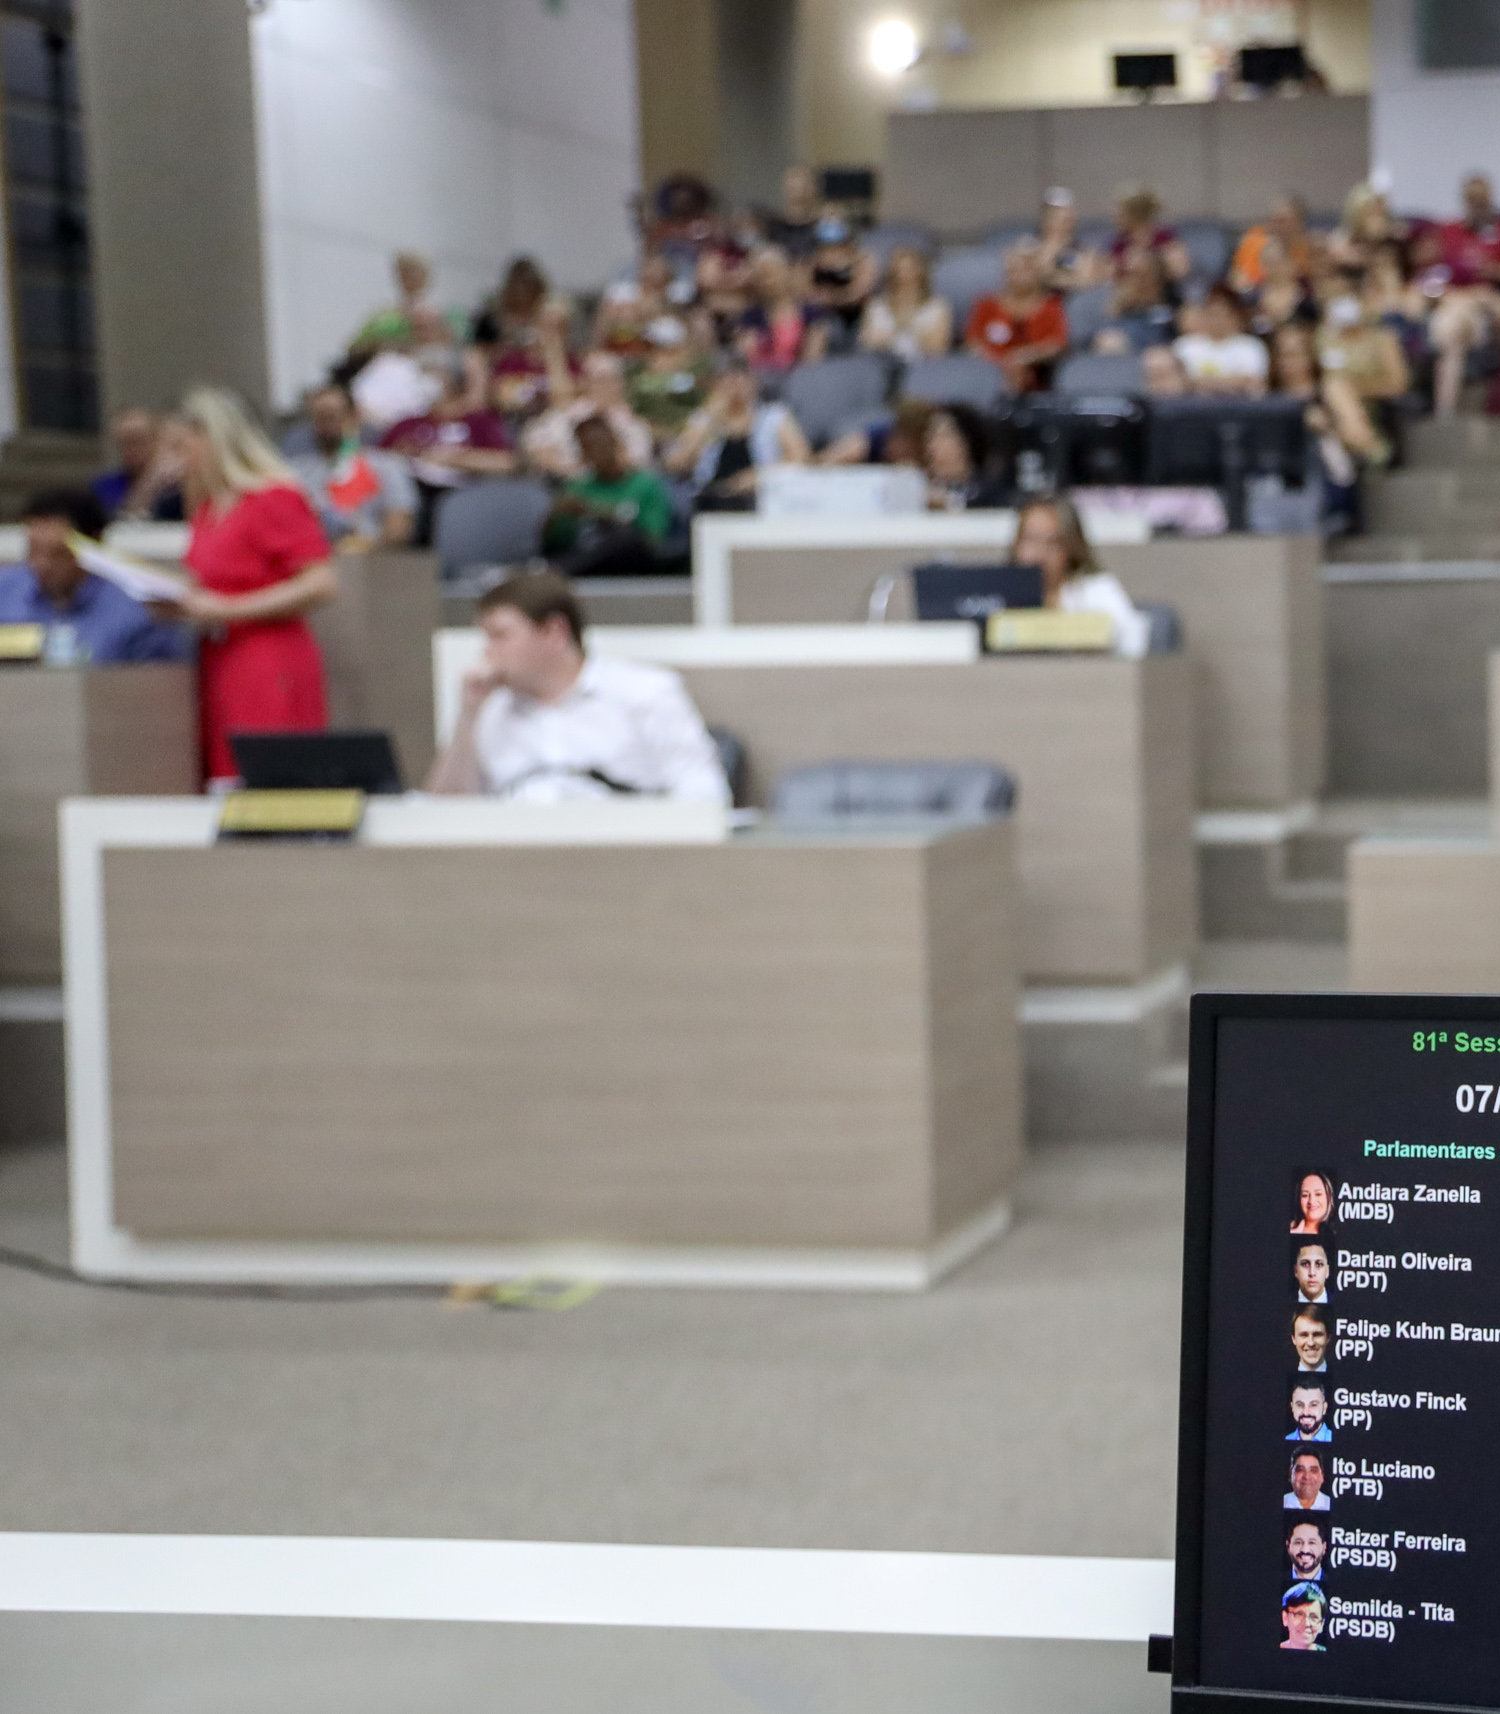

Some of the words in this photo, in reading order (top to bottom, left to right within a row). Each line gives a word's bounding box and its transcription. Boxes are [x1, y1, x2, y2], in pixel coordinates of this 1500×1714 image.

[1364, 1140, 1495, 1159] Parlamentares
[1338, 1183, 1409, 1201] Andiara
[1413, 1185, 1480, 1203] Zanella
[1338, 1202, 1394, 1224] (MDB)
[1338, 1250, 1396, 1268] Darlan
[1401, 1252, 1471, 1271] Oliveira
[1337, 1271, 1387, 1292] (PDT)
[1336, 1319, 1391, 1342] Felipe
[1396, 1321, 1445, 1340] Kuhn
[1335, 1339, 1374, 1361] (PP)
[1334, 1388, 1410, 1408] Gustavo
[1416, 1392, 1466, 1411] Finck
[1334, 1409, 1372, 1430] (PP)
[1333, 1457, 1356, 1475] Ito
[1361, 1459, 1435, 1479] Luciano
[1332, 1477, 1383, 1500] (PTB)
[1331, 1527, 1389, 1547] Raizer
[1394, 1531, 1466, 1552] Ferreira
[1331, 1547, 1396, 1572] (PSDB)
[1329, 1597, 1403, 1618] Semilda
[1421, 1602, 1454, 1622] Tita
[1329, 1618, 1395, 1642] (PSDB)
